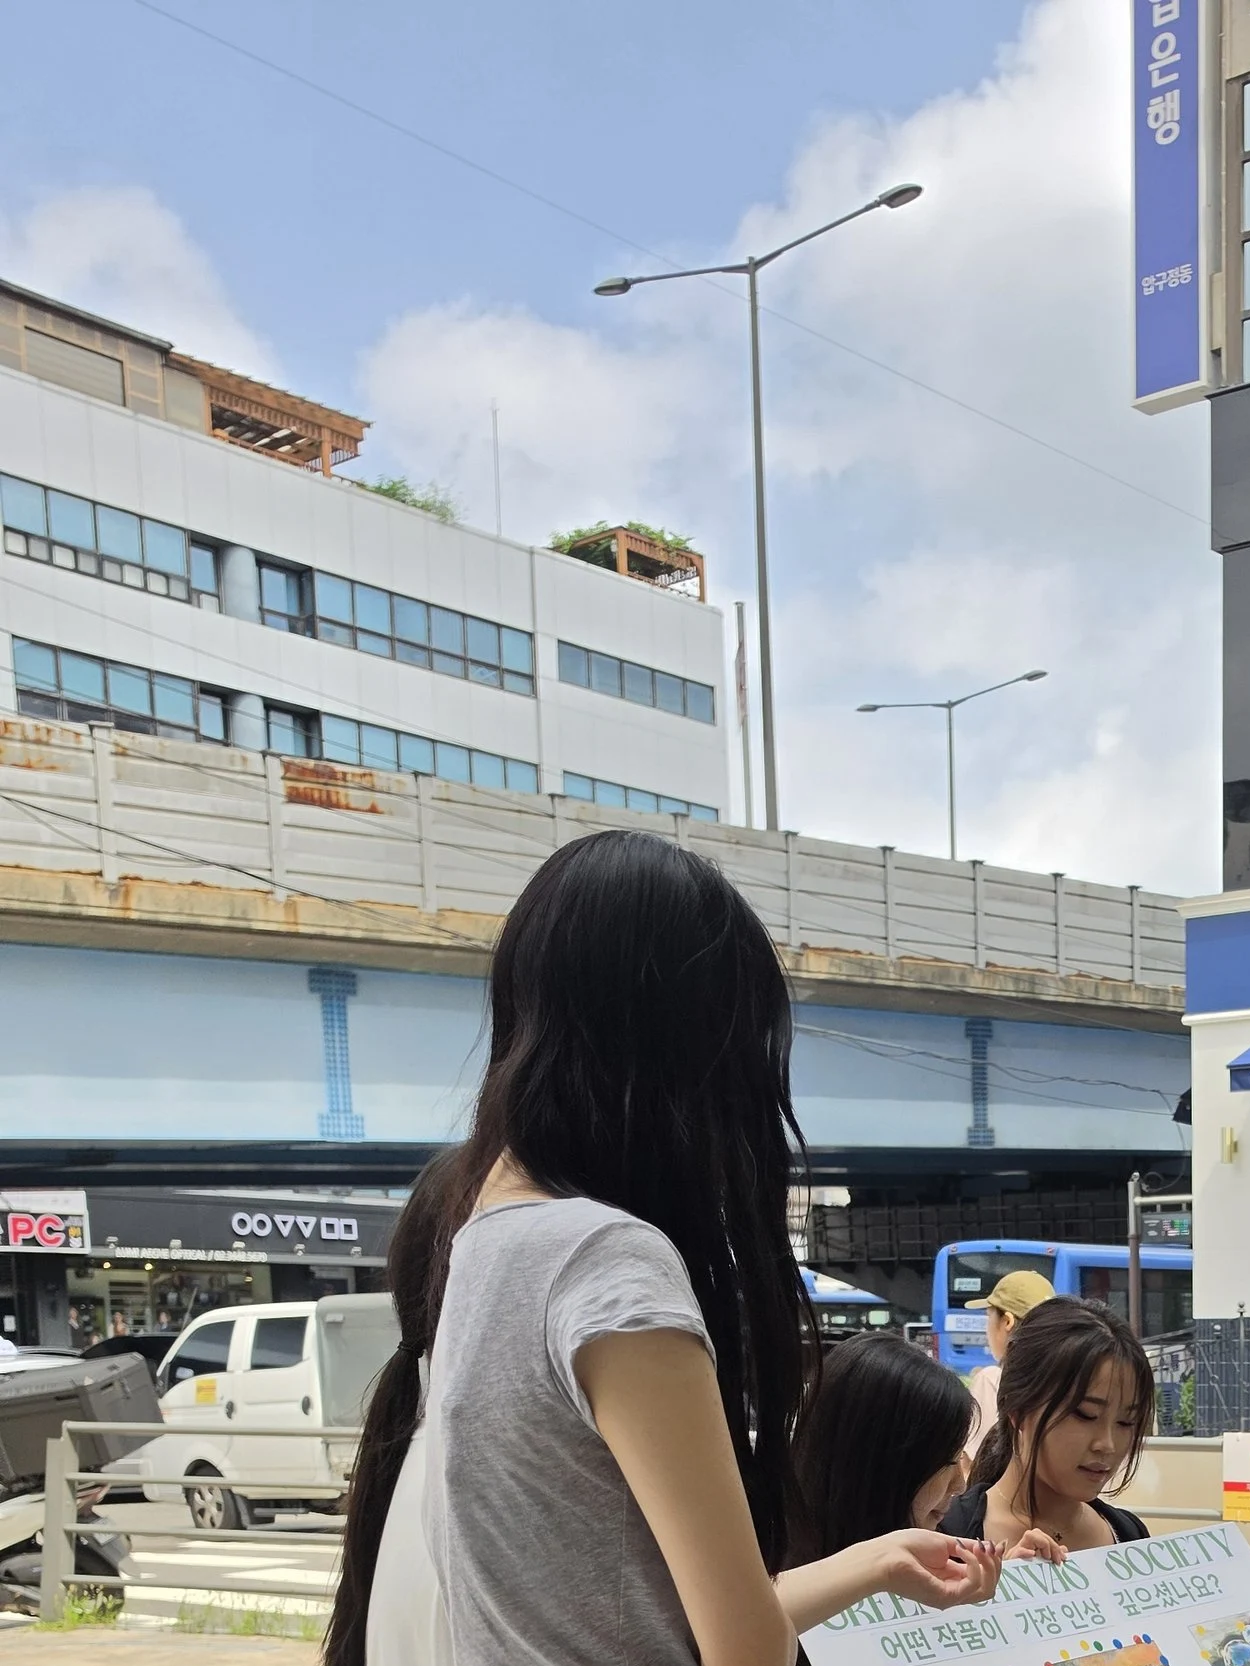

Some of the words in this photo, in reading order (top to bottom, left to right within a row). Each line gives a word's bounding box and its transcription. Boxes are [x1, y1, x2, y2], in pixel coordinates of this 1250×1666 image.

[1141, 263, 1193, 295] 압구정동
[1104, 1528, 1234, 1581] SOCIETY
[880, 1628, 937, 1663] 어떤
[937, 1614, 1009, 1653] 작품이
[1015, 1603, 1063, 1638] 가장
[1061, 1596, 1107, 1630] 인상
[1113, 1573, 1224, 1617] 깊으셨나요?
